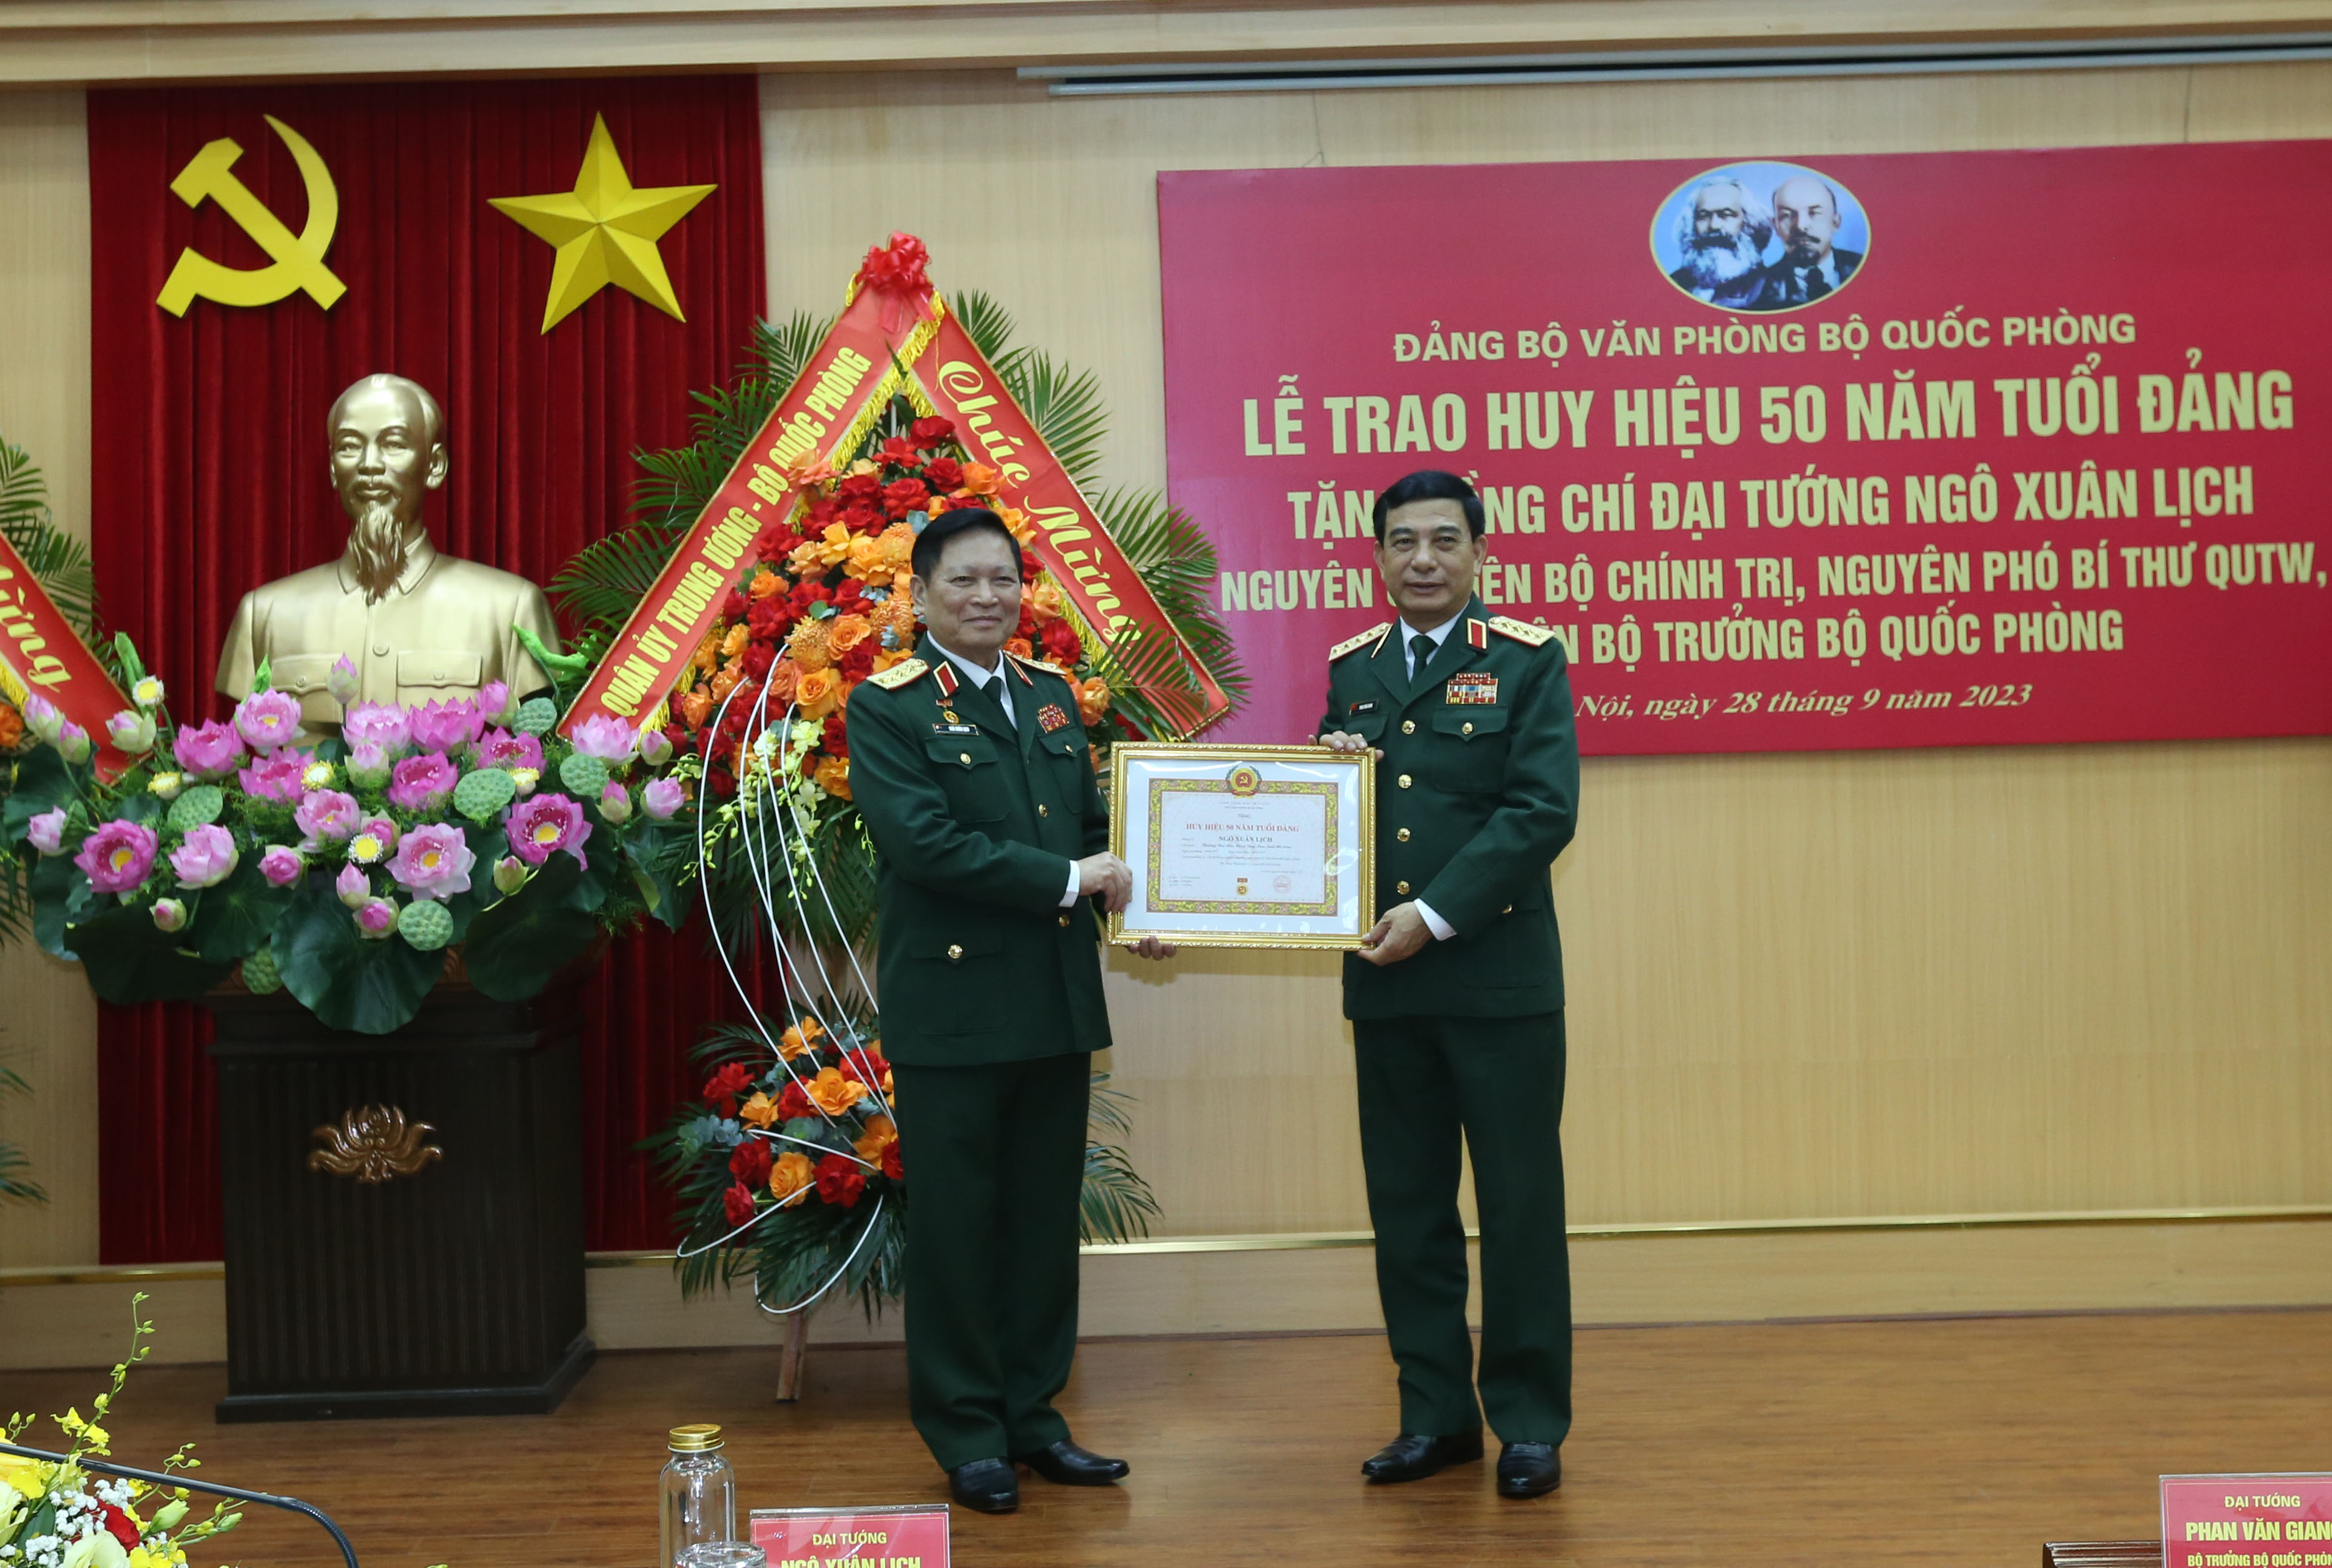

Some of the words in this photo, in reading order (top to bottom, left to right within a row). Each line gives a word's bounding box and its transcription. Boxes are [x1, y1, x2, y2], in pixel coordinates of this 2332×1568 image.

[1393, 320, 1504, 361] ĐẢNG
[1518, 321, 1568, 368] BỘ
[1580, 320, 1660, 357] VĂN
[1674, 317, 1805, 355] PHÒNG
[1819, 314, 1869, 360] BỘ
[1881, 305, 1990, 350] QUỐC
[2003, 308, 2135, 346] PHÒNG
[804, 347, 872, 422] PHÒNG
[1243, 375, 1306, 456] LỄ
[1323, 393, 1466, 454] TRAO
[1487, 390, 1594, 449] HUY
[1614, 375, 1740, 459] HIỆU
[1760, 385, 1826, 444] 50
[1846, 369, 1976, 441] NĂM
[1994, 352, 2119, 436] TUỔI
[2137, 348, 2293, 433] ĐẢNG
[769, 417, 826, 471] QUỐC
[747, 463, 793, 506] BỘ
[938, 360, 1030, 489] Chúc
[1023, 496, 1142, 650] Mừng
[1287, 480, 1375, 550] TẶN
[1467, 471, 1545, 535] NG
[1561, 473, 1635, 532] CHÍ
[1650, 481, 1725, 541] ĐẠI
[1740, 464, 1889, 527] TƯỚNG
[1905, 463, 1997, 523] NGÔ
[2014, 460, 2137, 521] XUÂN
[2153, 466, 2253, 527] LỊCH
[701, 507, 762, 571] ƯƠNG
[655, 561, 724, 634] TRUNG
[1222, 560, 1373, 612] NGUYÊN
[1545, 554, 1594, 611] BỘ
[1607, 551, 1724, 601] CHÍNH
[1735, 557, 1805, 607] TRỊ,
[1818, 544, 1970, 596] NGUYÊN
[1983, 541, 2059, 591] PHÓ
[2072, 539, 2109, 589] BÍ
[2120, 542, 2197, 587] THƯ
[2206, 542, 2326, 590] QUTW,
[632, 624, 679, 664] ỦY
[1592, 614, 1641, 672] BỘ
[1653, 603, 1804, 662] TRƯỞNG
[1817, 609, 1866, 667] BỘ
[1880, 600, 1980, 661] QUỐC
[1994, 602, 2123, 653] PHÒNG
[600, 654, 660, 717] QUÂN
[1574, 695, 1634, 721] Nội,
[1644, 692, 1718, 720] ngày
[1723, 691, 1763, 714] 28
[1767, 690, 1855, 717] tháng
[1861, 688, 1881, 709] 9
[1884, 689, 1952, 710] năm
[1959, 684, 2032, 707] 2023
[2185, 1521, 2238, 1541] PHAN
[2242, 1517, 2280, 1541] VĂN
[2225, 1496, 2249, 1511] ĐẠI
[2252, 1492, 2301, 1507] TƯỚNG
[812, 1532, 836, 1548] ĐẠI
[839, 1529, 888, 1545] TƯỚNG
[2187, 1552, 2203, 1568] BỘ
[2205, 1549, 2251, 1567] TRƯỞNG
[2253, 1552, 2269, 1568] BỘ
[2271, 1550, 2302, 1567] QUỐC
